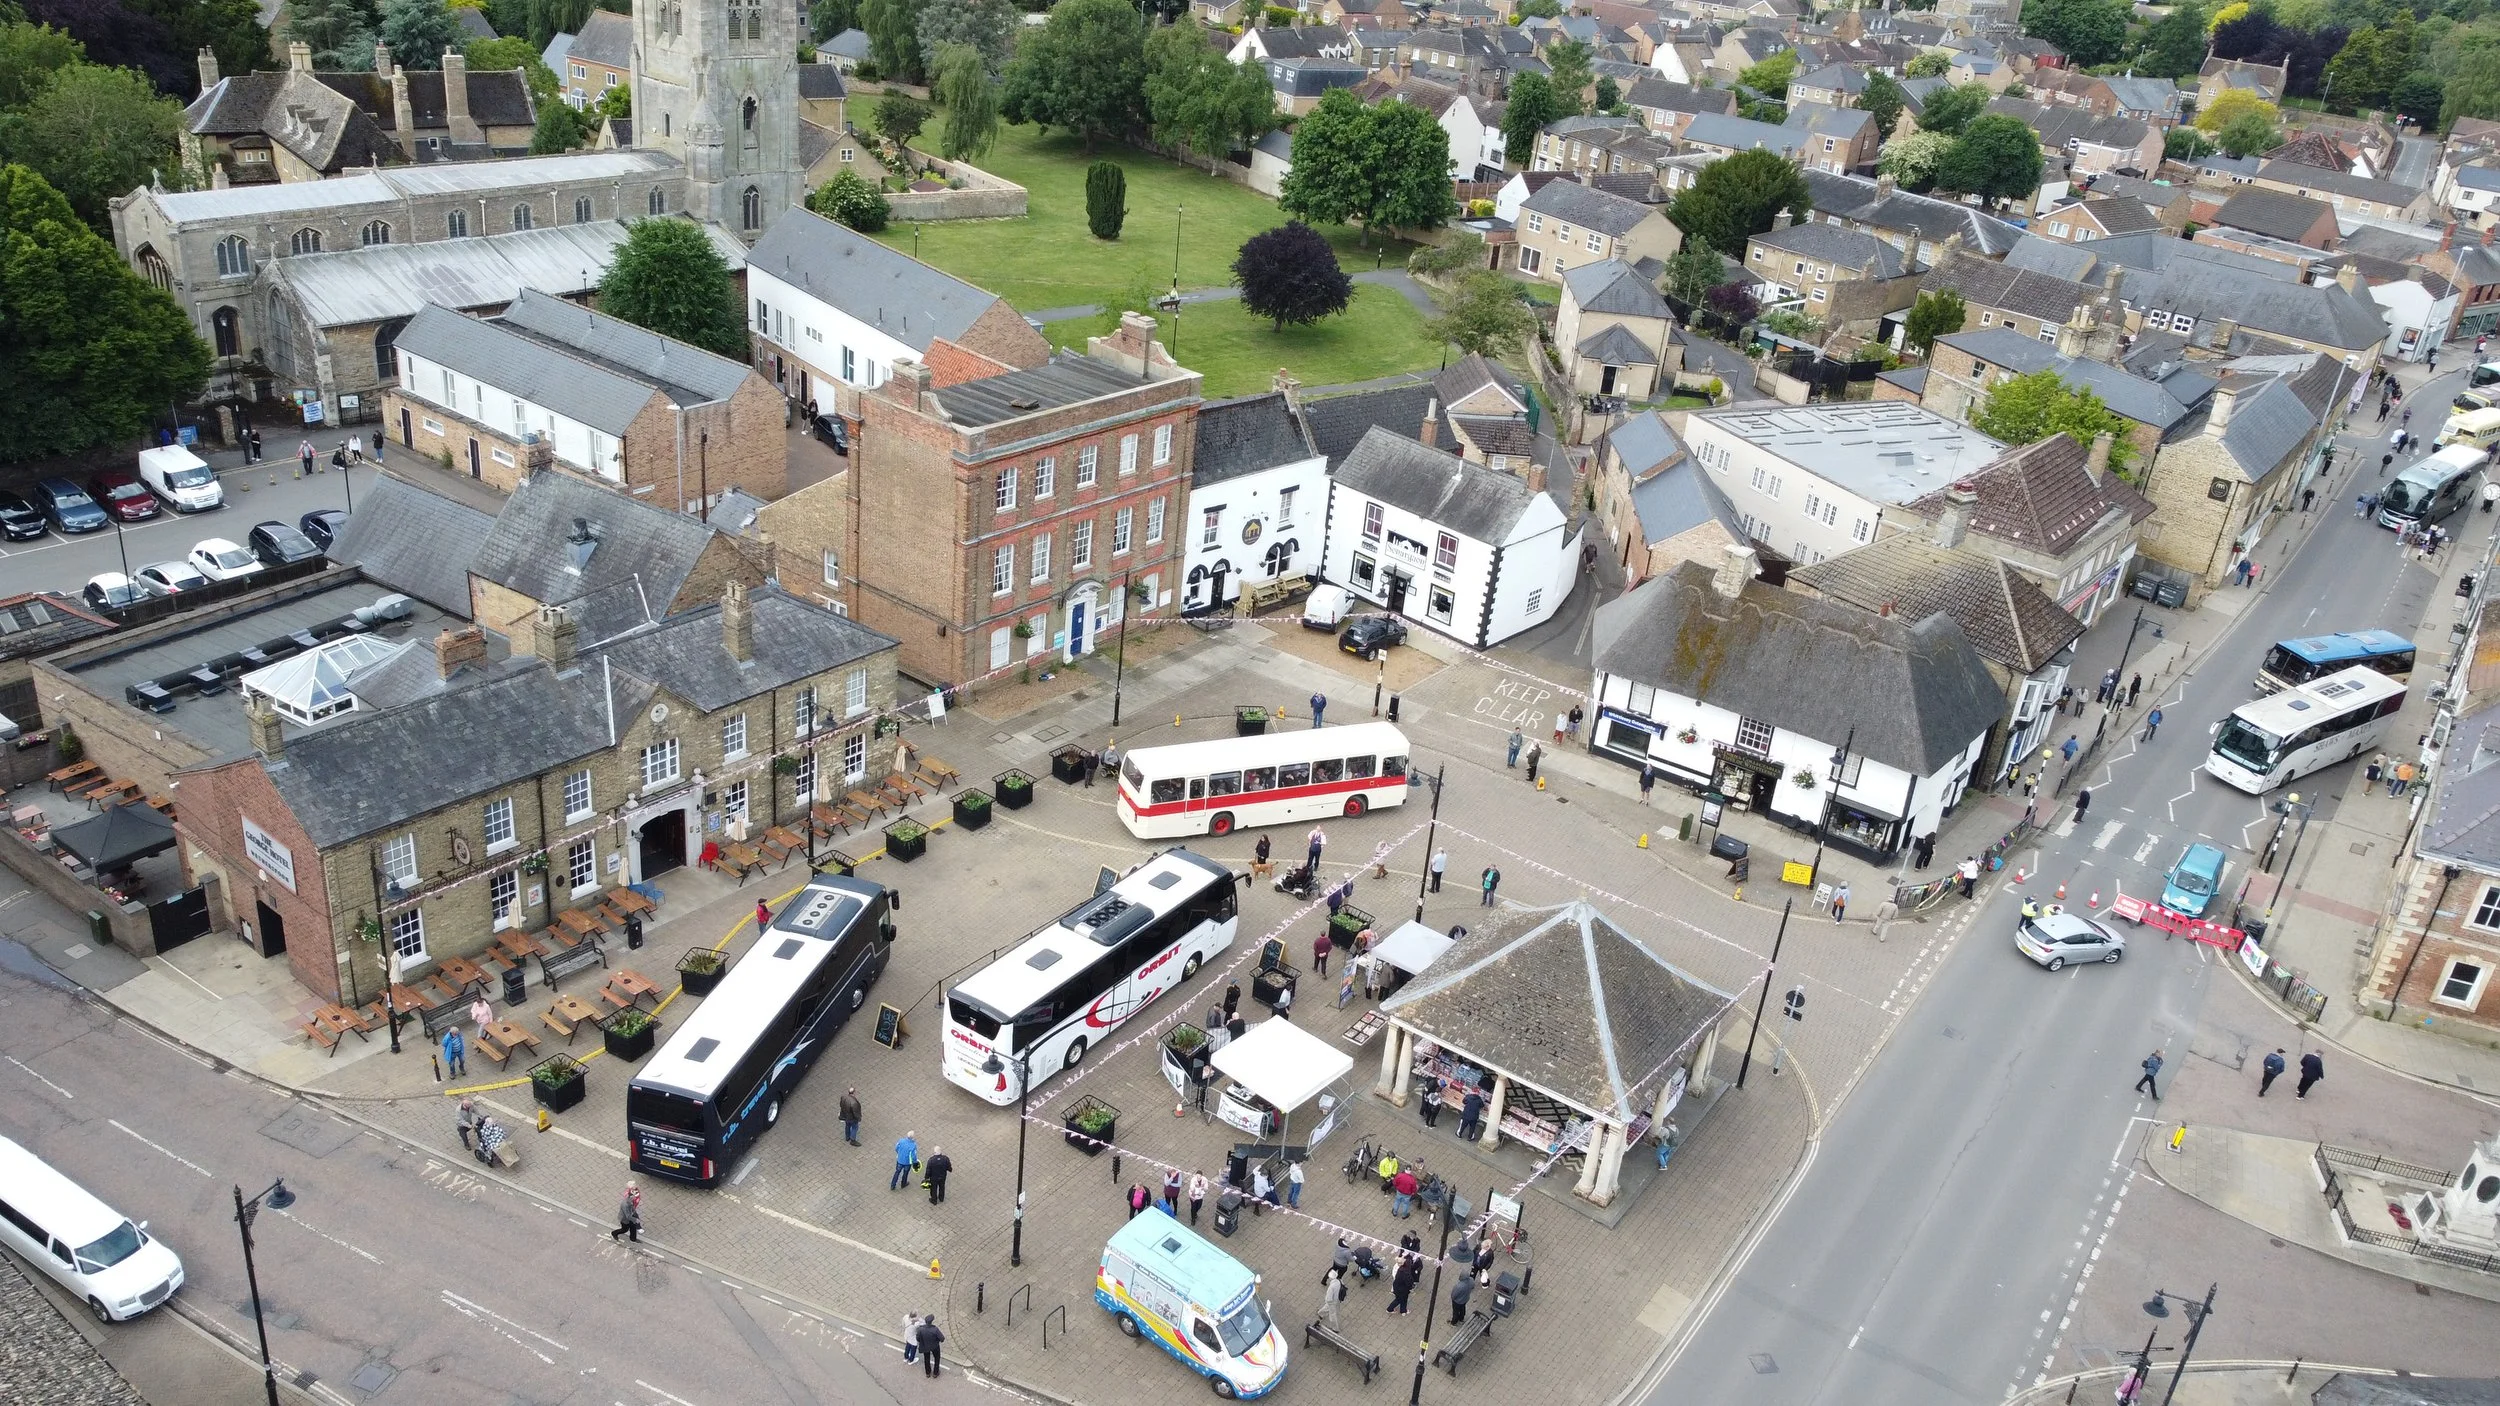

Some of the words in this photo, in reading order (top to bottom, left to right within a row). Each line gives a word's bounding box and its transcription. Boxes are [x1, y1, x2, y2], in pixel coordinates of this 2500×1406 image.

[1494, 679, 1551, 704] KEEP
[1474, 697, 1544, 729] CLEAR
[245, 830, 270, 854] GEORGE
[269, 848, 290, 870] HOTEL
[260, 832, 272, 848] THE
[1138, 943, 1182, 980] ORBIT
[951, 1029, 992, 1054] ORBIT
[741, 1080, 768, 1120] travel
[642, 1138, 658, 1147] r.b.
[660, 1142, 688, 1154] travel
